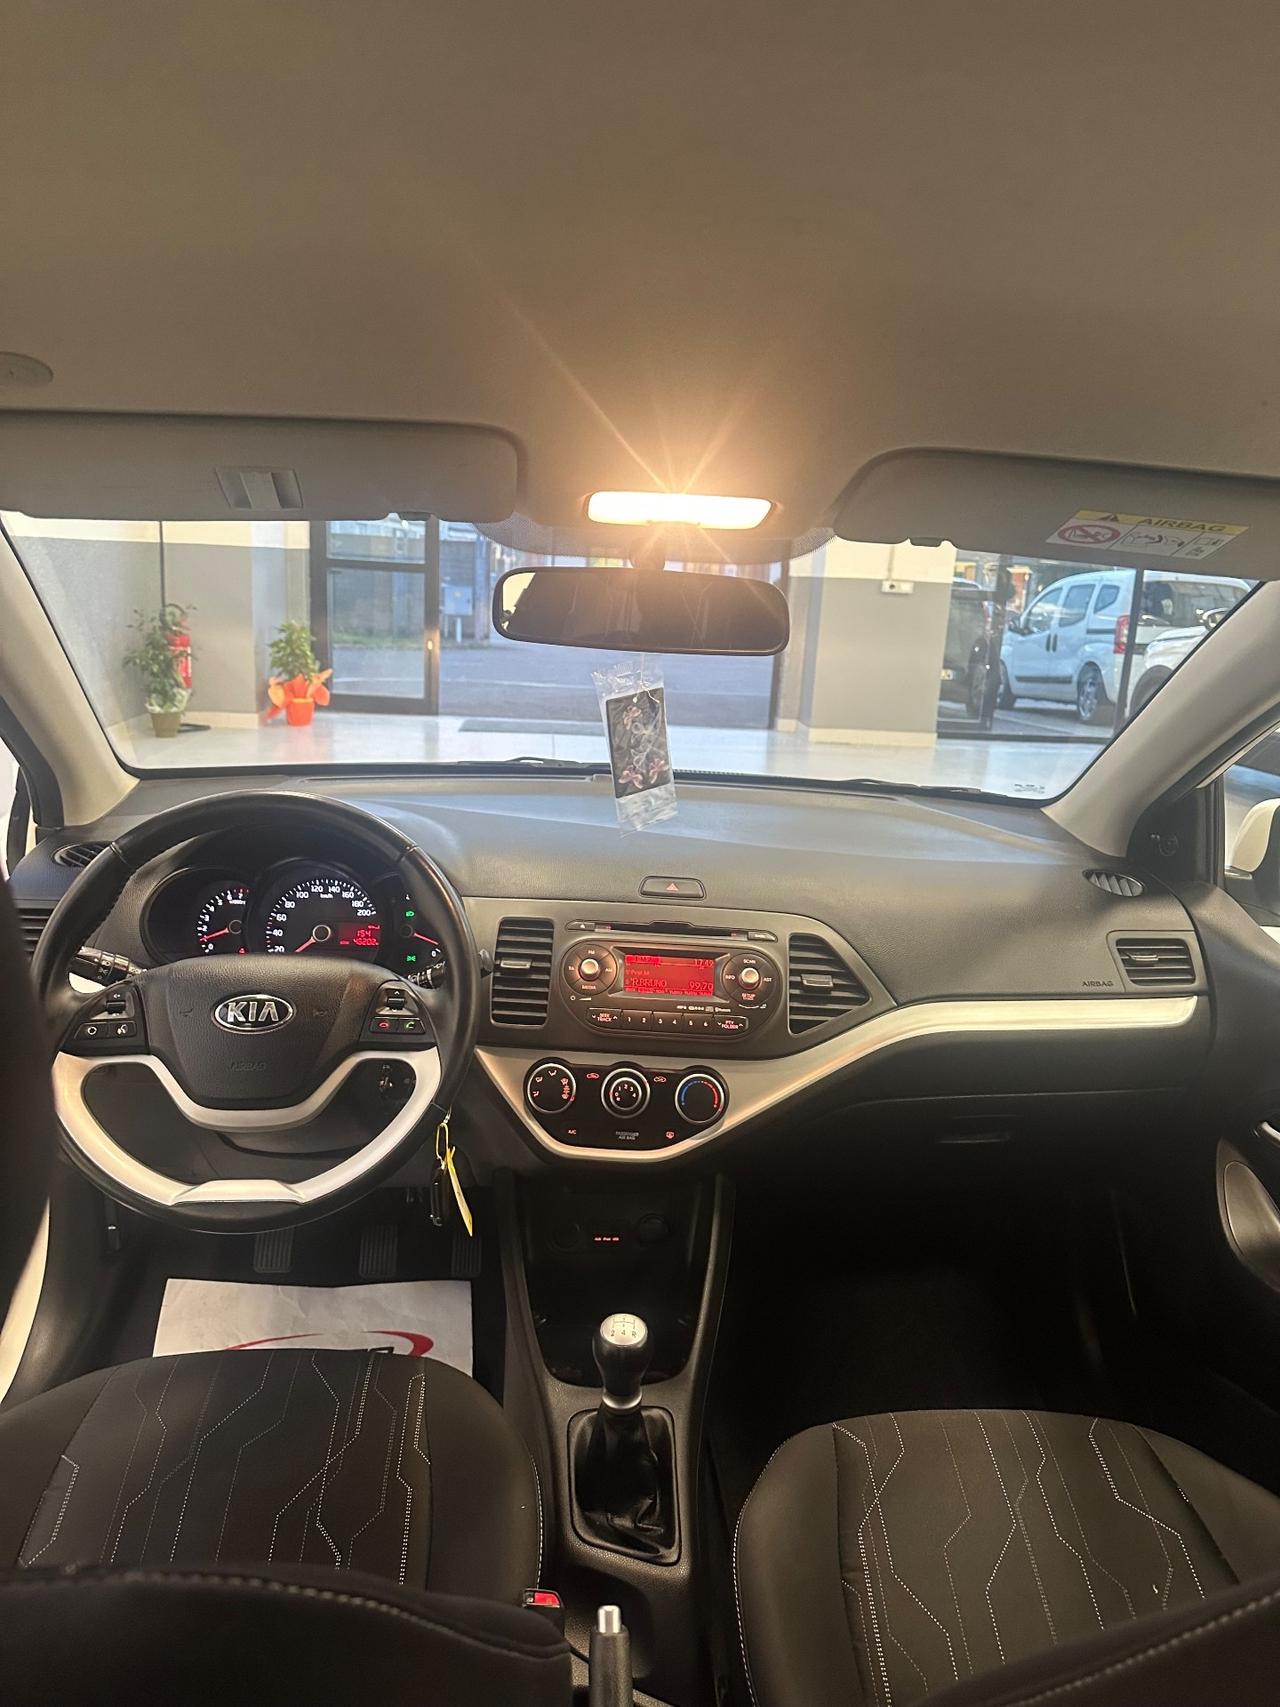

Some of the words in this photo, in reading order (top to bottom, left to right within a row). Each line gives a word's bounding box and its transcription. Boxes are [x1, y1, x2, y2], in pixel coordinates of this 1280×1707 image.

[1137, 518, 1226, 532] AIRBAG
[296, 891, 309, 899] 100
[276, 913, 287, 921] 60
[274, 945, 285, 953] 20
[227, 1001, 279, 1022] KIA
